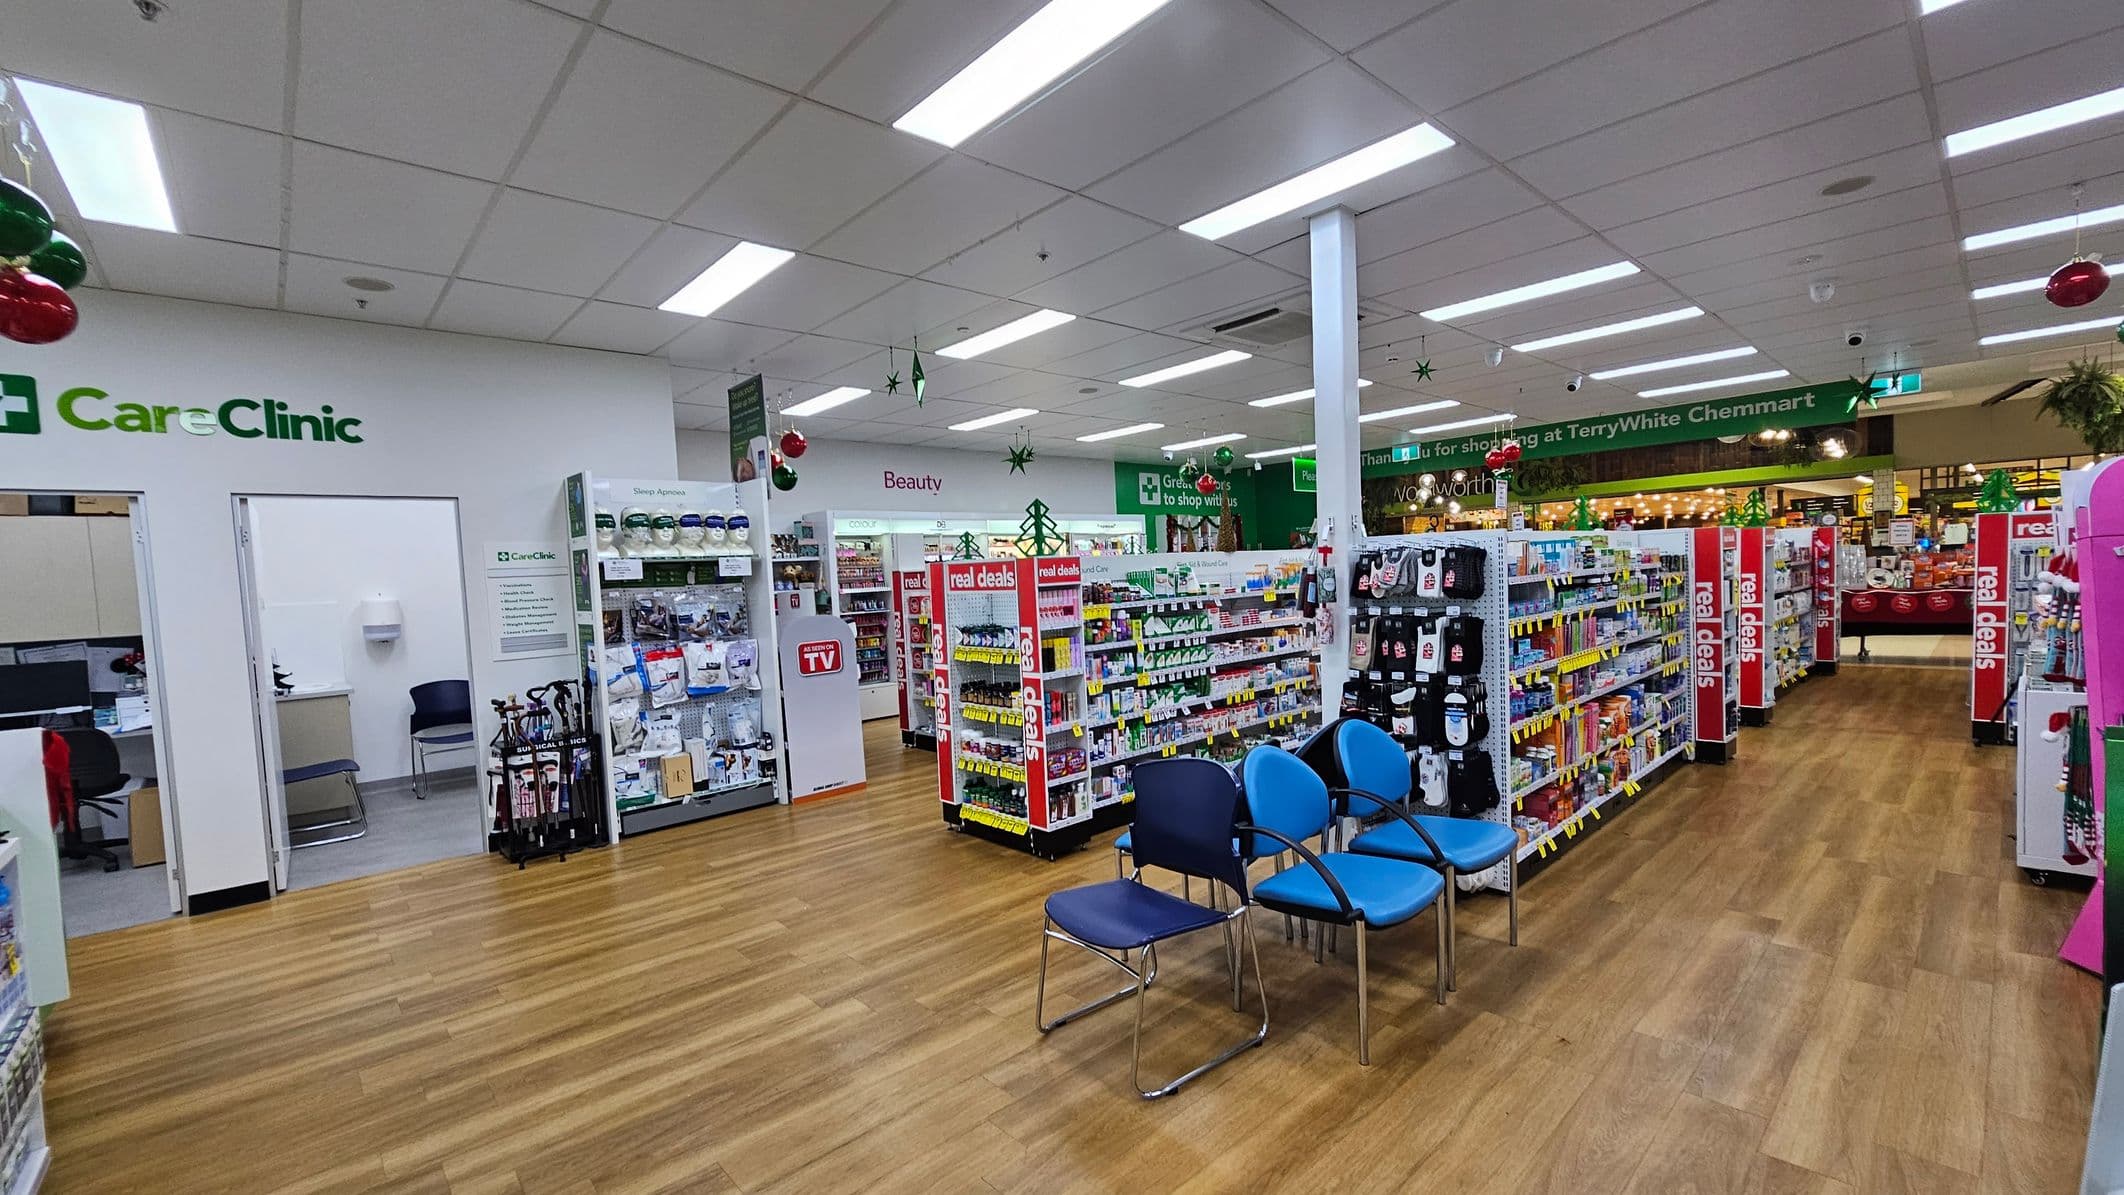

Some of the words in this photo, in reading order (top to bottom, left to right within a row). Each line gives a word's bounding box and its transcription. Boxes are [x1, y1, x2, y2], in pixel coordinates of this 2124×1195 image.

[57, 386, 364, 444] CareClinic
[1360, 451, 1392, 466] Than
[1435, 443, 1458, 457] for
[1462, 431, 1538, 454] shopng
[1543, 428, 1563, 443] at
[1567, 412, 1681, 439] TerryWhite
[1688, 392, 1816, 423] Chemmart
[633, 487, 655, 496] Sleep
[657, 488, 686, 497] Apnoea
[884, 471, 942, 495] Beauty
[1163, 492, 1176, 505] to
[1178, 491, 1202, 510] shop
[1393, 472, 1495, 502] wolworth
[511, 551, 556, 561] CareClinic
[1039, 564, 1056, 577] real
[1058, 562, 1080, 576] deals
[1082, 565, 1095, 573] und
[904, 575, 921, 589] real
[951, 566, 974, 588] real
[977, 565, 1015, 588] deals
[1741, 573, 1764, 607] real
[1978, 566, 2009, 607] real
[1696, 581, 1722, 623] real
[894, 611, 905, 642] real
[1741, 612, 1764, 662] deals
[1975, 612, 2009, 669] deals
[804, 650, 835, 671] TV
[933, 623, 949, 669] real
[1020, 626, 1042, 679] real
[1696, 629, 1722, 688] deals
[896, 646, 908, 690] deals
[935, 675, 951, 743] deals
[1023, 686, 1045, 761] deals
